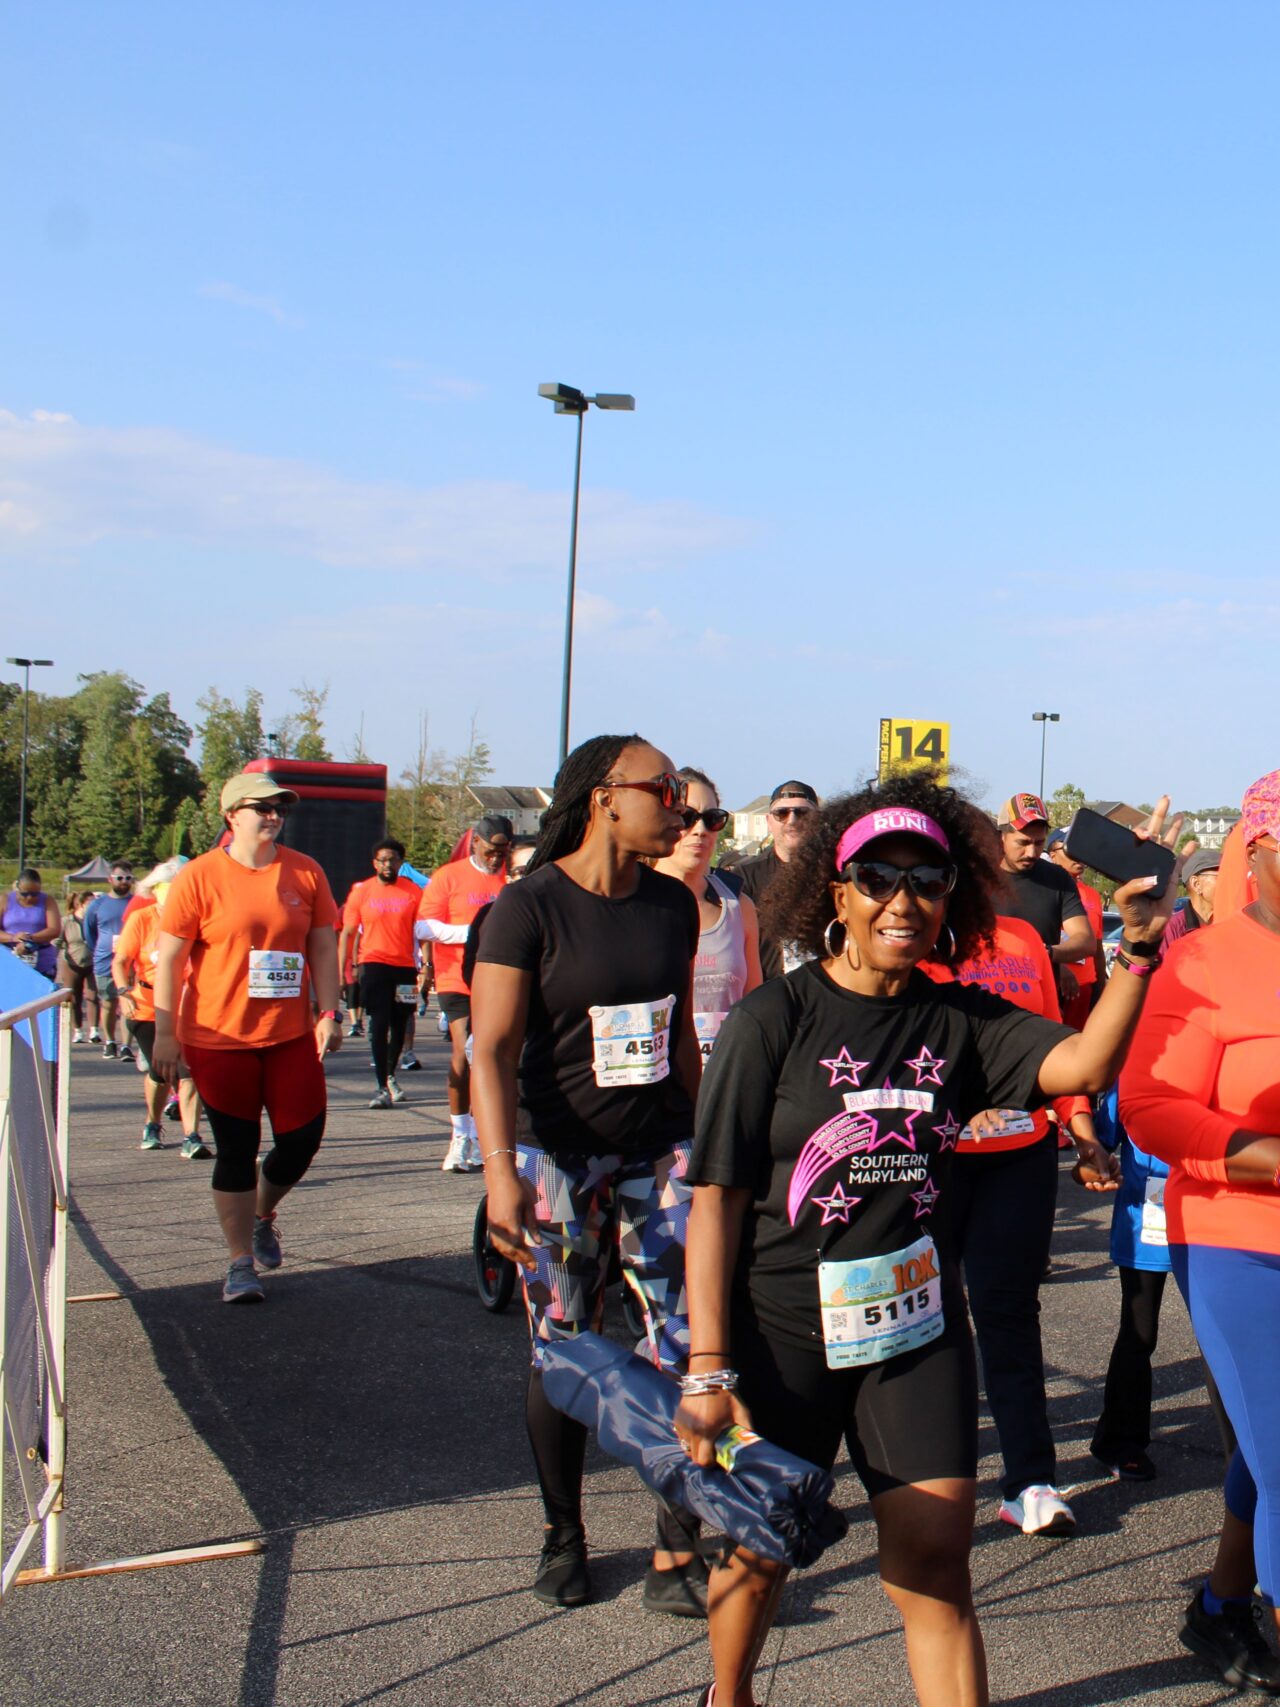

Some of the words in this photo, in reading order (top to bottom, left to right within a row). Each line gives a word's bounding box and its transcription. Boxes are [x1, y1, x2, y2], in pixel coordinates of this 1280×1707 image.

[881, 720, 890, 744] PACE
[896, 726, 945, 764] 14
[874, 815, 928, 833] RUN!
[267, 972, 296, 981] 4543
[849, 1093, 879, 1108] BLACK
[831, 1114, 851, 1129] COUNTY
[838, 1122, 858, 1136] COUNTY
[849, 1128, 870, 1140] COUNTY
[848, 1138, 870, 1150] COUNTY
[850, 1153, 929, 1169] SOUTHERN
[849, 1168, 927, 1185] MARYLAND
[892, 1247, 938, 1294] 10K
[864, 1286, 930, 1326] 5115
